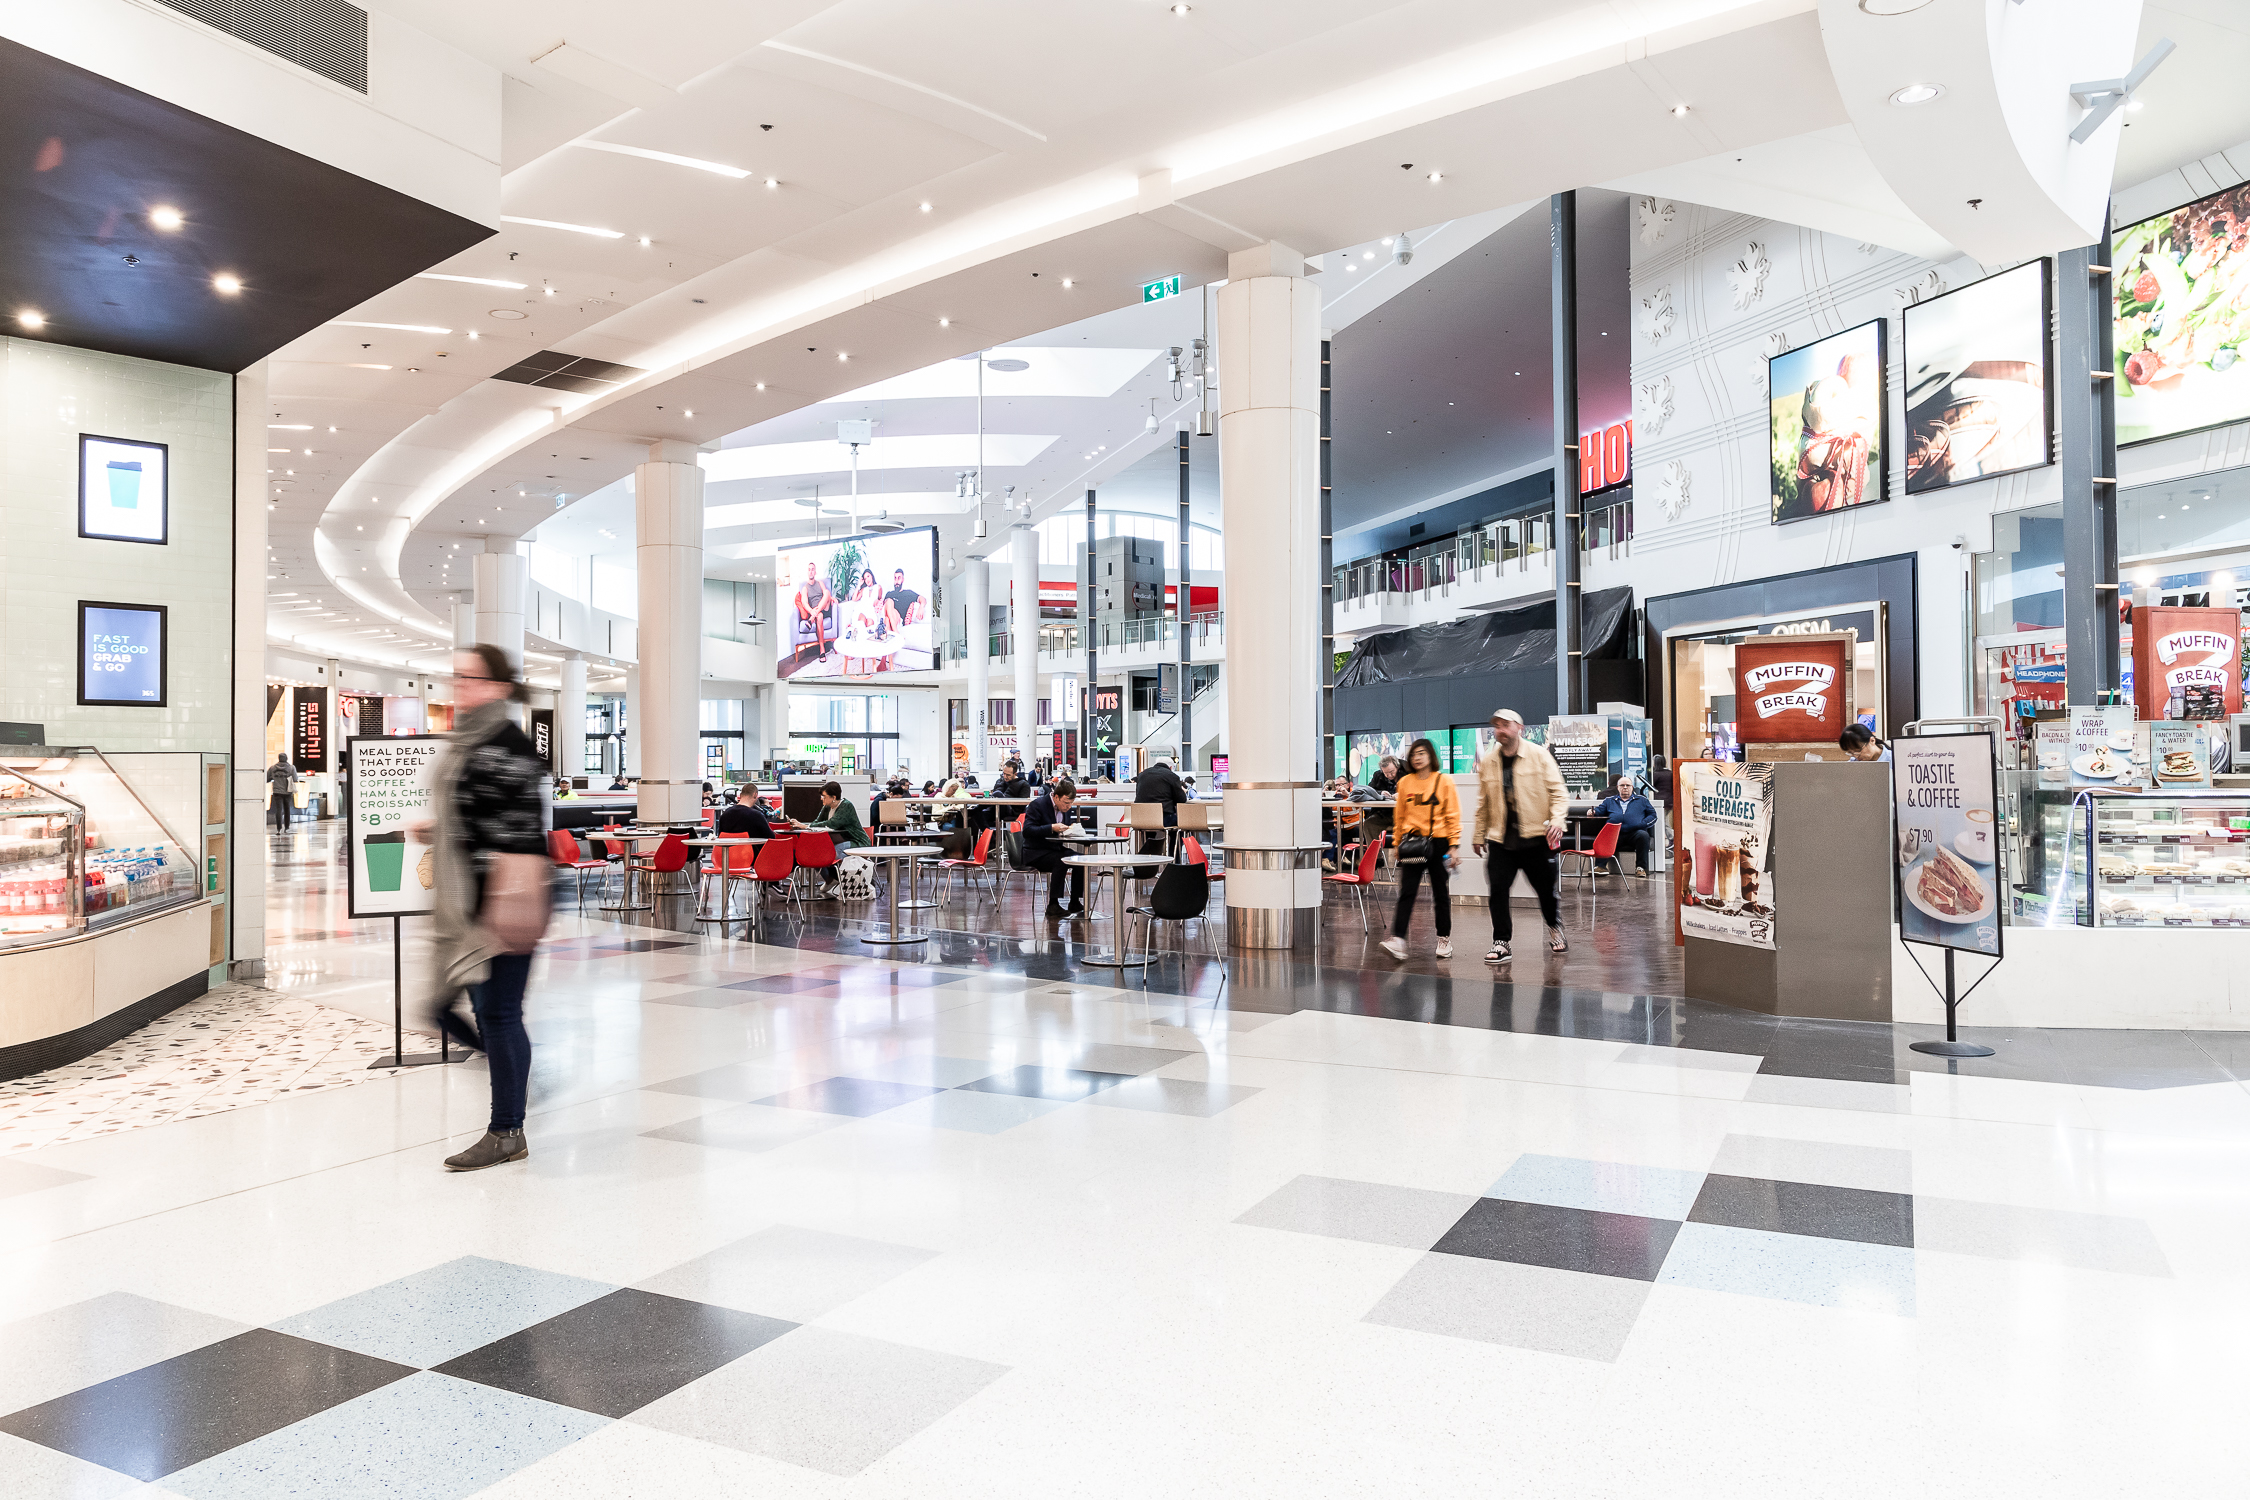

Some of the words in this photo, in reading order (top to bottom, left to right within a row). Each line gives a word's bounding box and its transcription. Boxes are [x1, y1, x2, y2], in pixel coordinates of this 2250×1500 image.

[93, 634, 130, 644] FAST
[2169, 635, 2227, 651] MUFFIN
[93, 643, 106, 652] IS
[110, 644, 148, 654] GOOD
[92, 652, 132, 663] GRAB
[92, 662, 102, 671] &
[105, 663, 125, 672] GO
[1755, 665, 1824, 681] MUFFIN
[2176, 669, 2222, 684] BREAK
[1084, 693, 1118, 710] YTS
[1762, 695, 1818, 709] BREAK
[2081, 719, 2104, 727] WRAP
[2075, 728, 2081, 736] &
[2082, 728, 2109, 736] COFFEE
[1554, 737, 1575, 746] WIN
[359, 748, 392, 756] MEAL
[396, 747, 436, 755] DEALS
[359, 758, 392, 766] THAT
[395, 757, 425, 766] FEEL
[359, 769, 376, 777] SO
[380, 768, 416, 777] GOOD!
[1908, 763, 1956, 785] TOASTIE
[359, 779, 406, 788] COFFEE
[1716, 779, 1741, 799] COLD
[360, 789, 387, 798] HAM
[390, 789, 397, 797] &
[1907, 788, 1917, 808] &
[1918, 787, 1960, 809] COFFEE
[359, 799, 429, 808] CROISSANT
[1701, 795, 1756, 820] BEVERAGES
[360, 813, 401, 826] $8.00
[1909, 827, 1933, 851] $7.90
